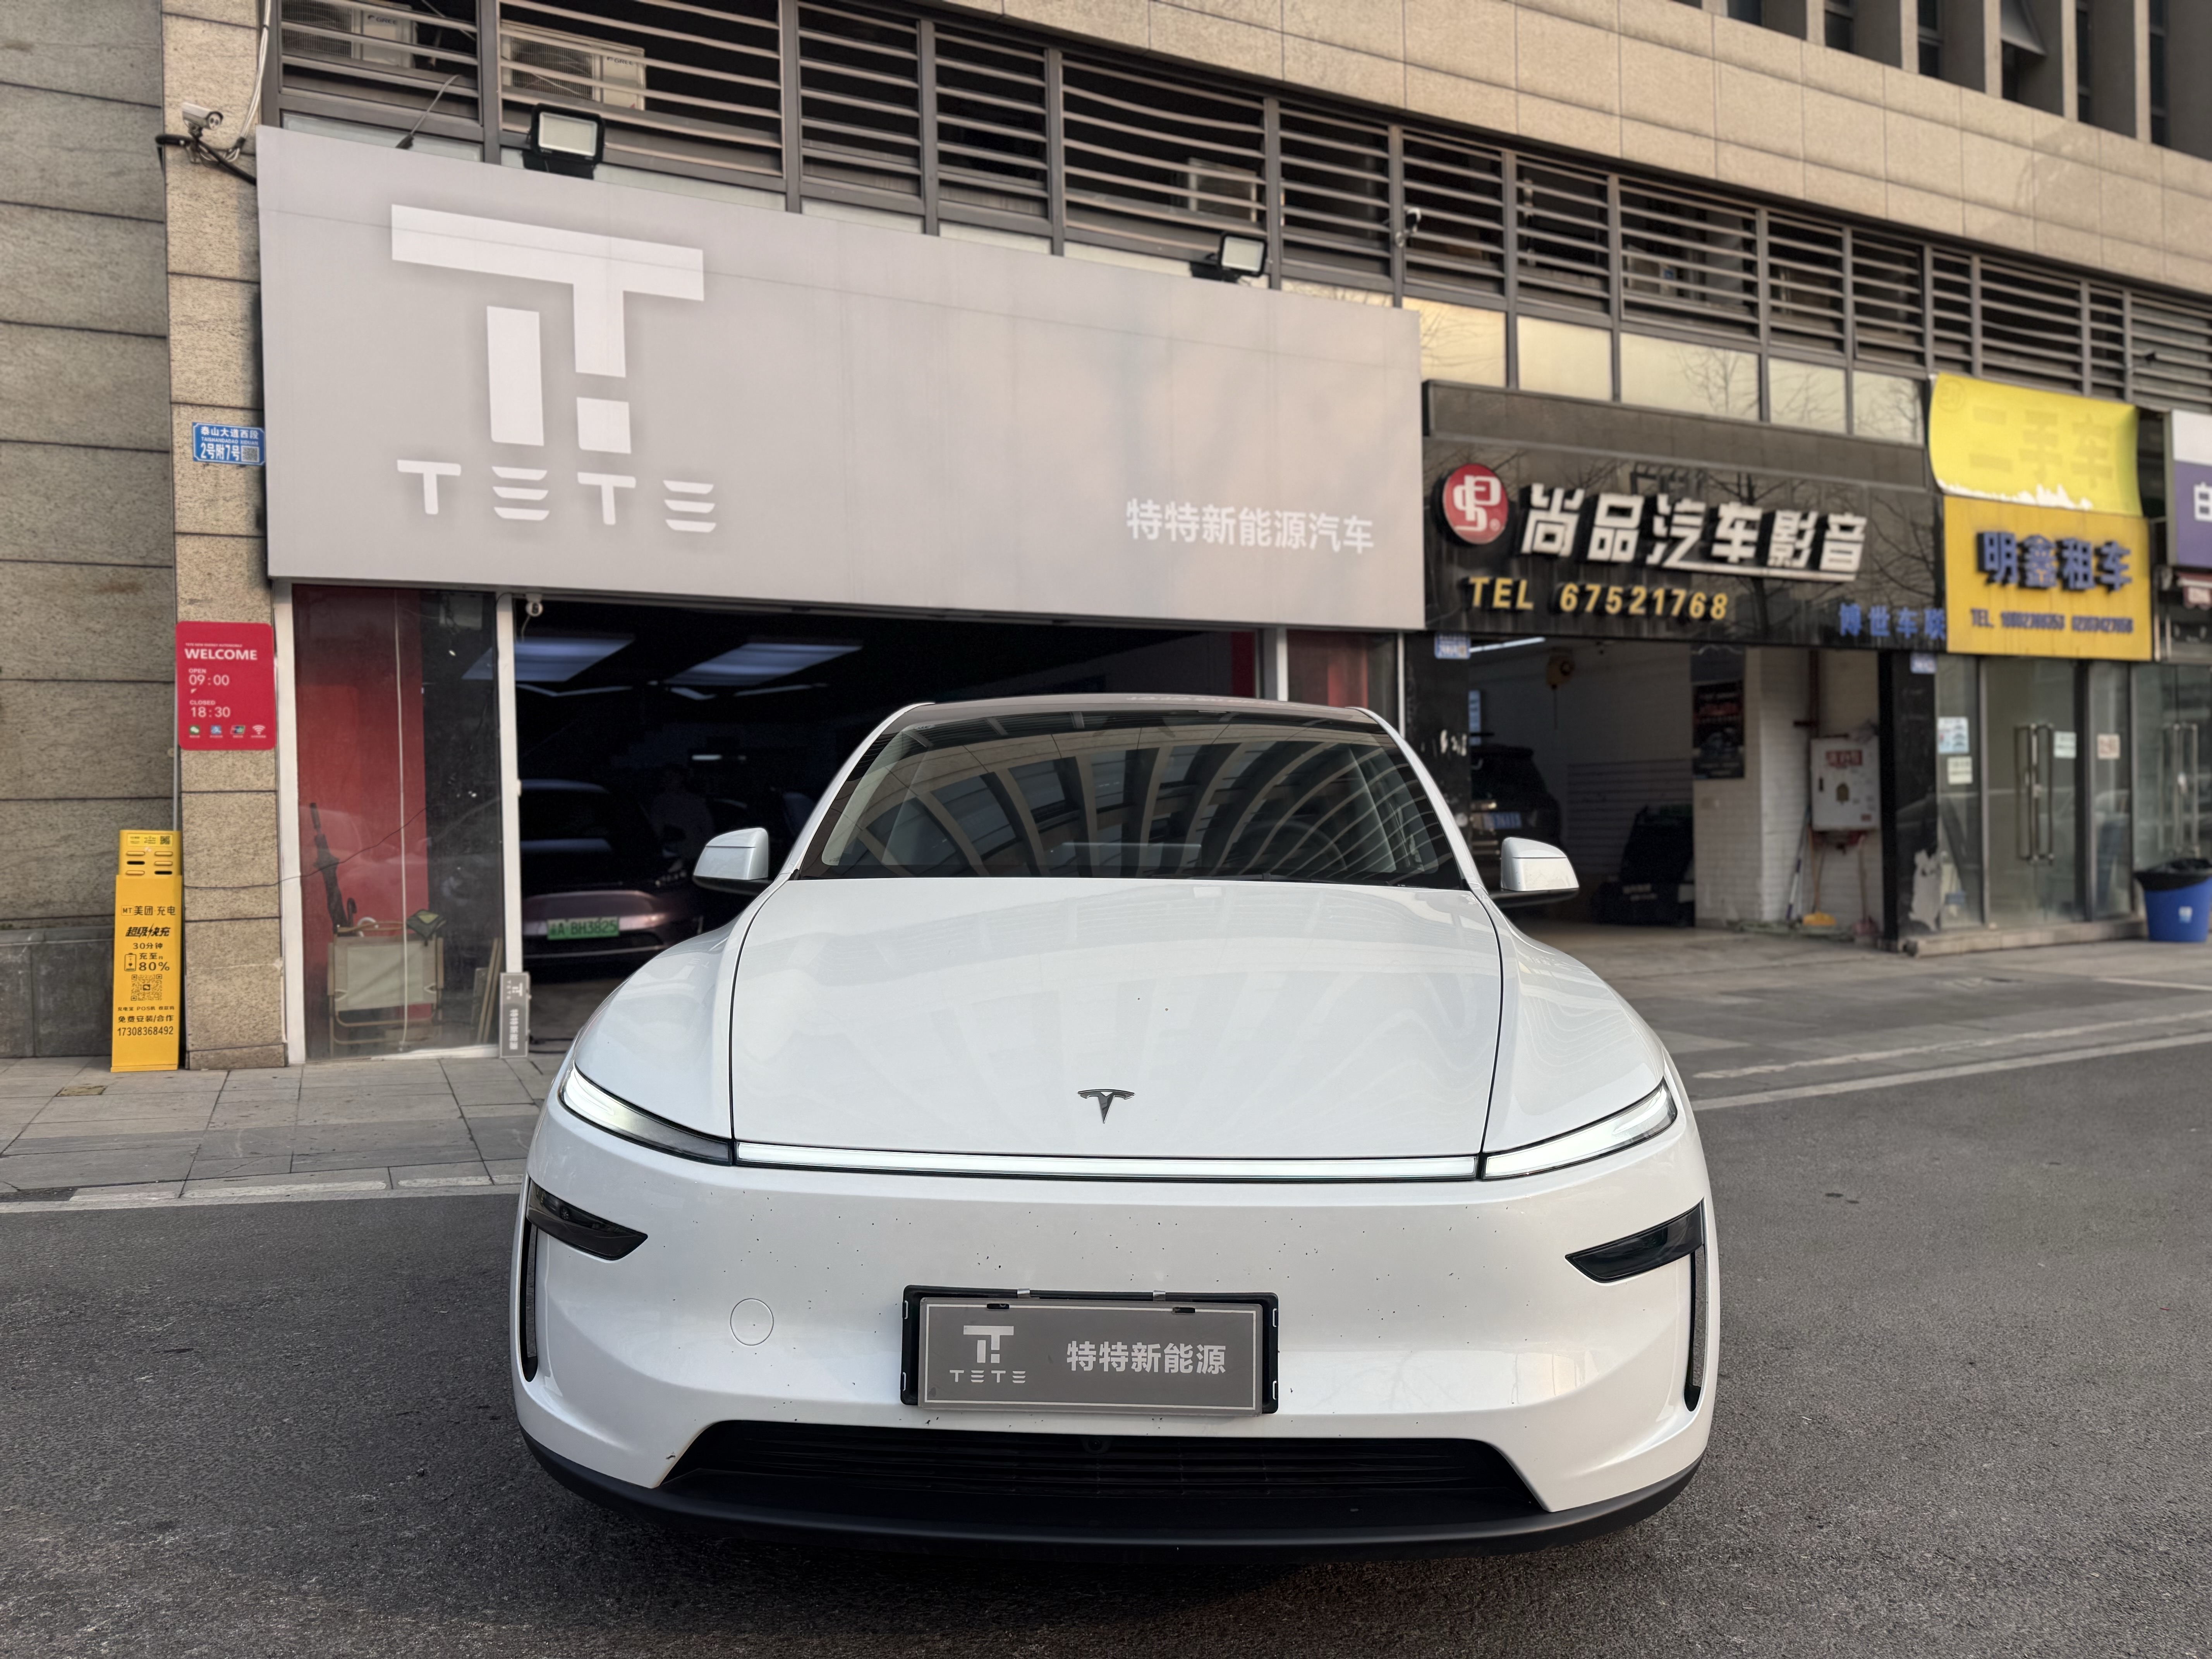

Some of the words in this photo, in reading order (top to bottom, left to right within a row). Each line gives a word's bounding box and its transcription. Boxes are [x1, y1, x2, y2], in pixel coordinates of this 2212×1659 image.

[201, 426, 258, 440] 泰山大道西段
[201, 443, 240, 461] 2号附7号
[397, 459, 716, 532] TETE
[1126, 498, 1374, 554] 特特新能源汽车
[1521, 483, 1867, 581] 尚品汽车影音
[1977, 532, 2133, 592] 明鑫租车
[1469, 577, 1534, 610] TEL
[1559, 583, 1728, 620] 67521768
[184, 648, 257, 660] WELCOME
[125, 925, 171, 938] 超级快充
[139, 962, 170, 971] 80%
[118, 1015, 174, 1023] 免费安装/合作
[117, 1026, 174, 1036] 17308368492
[1067, 1340, 1226, 1375] 特特新能源
[950, 1370, 1025, 1383] TETE
